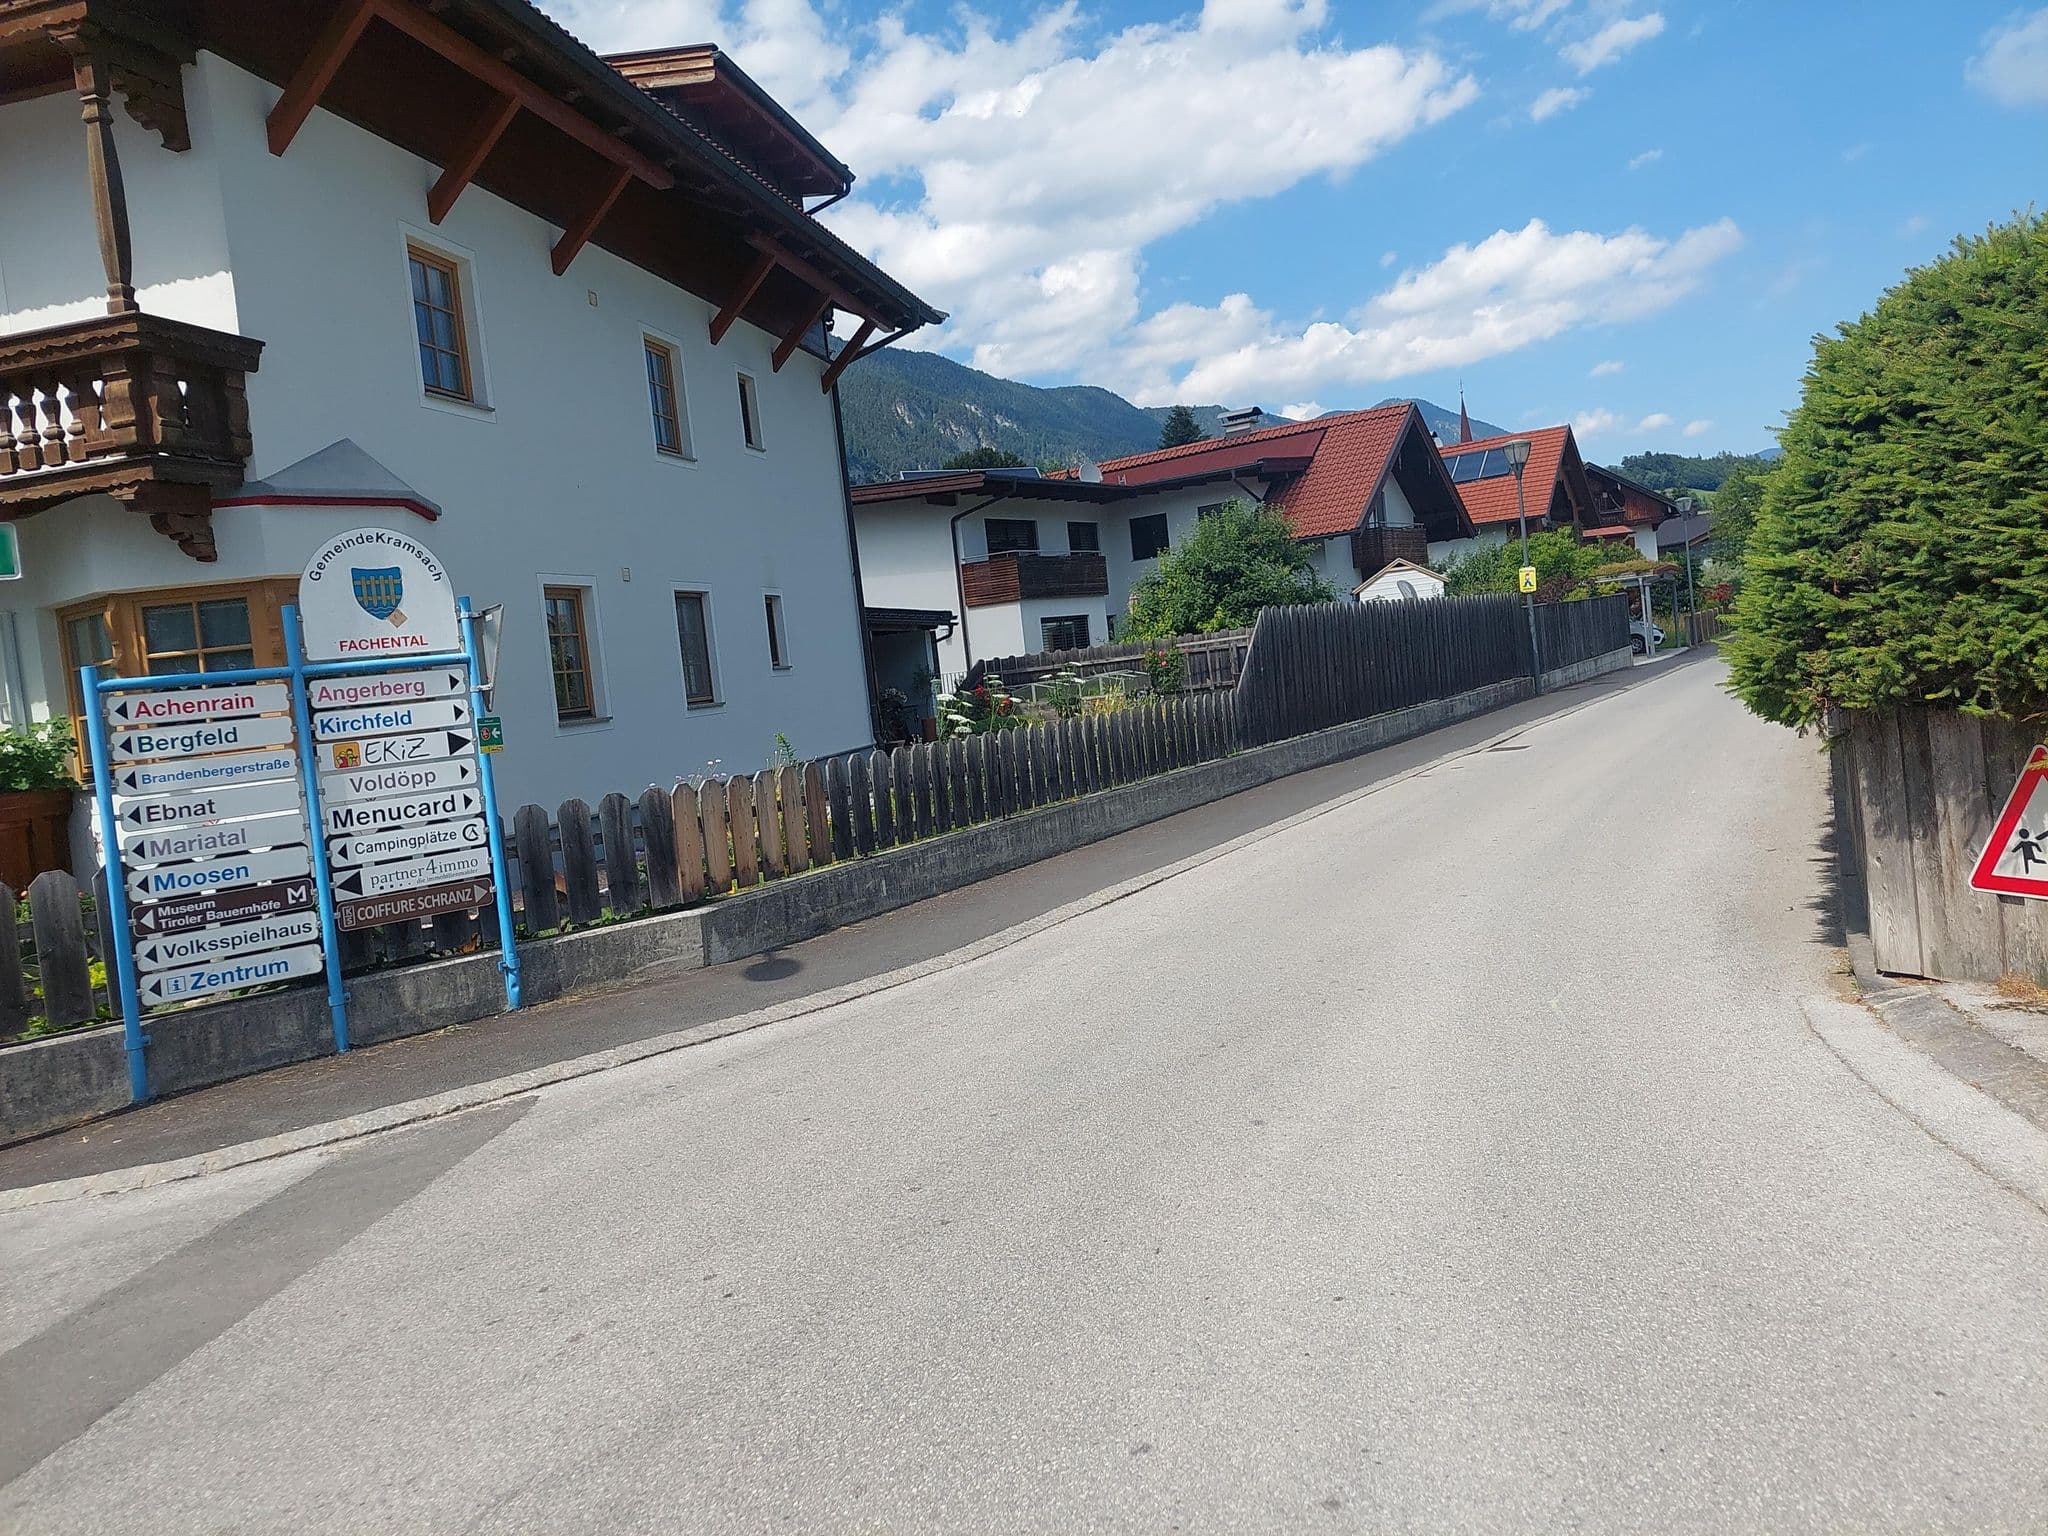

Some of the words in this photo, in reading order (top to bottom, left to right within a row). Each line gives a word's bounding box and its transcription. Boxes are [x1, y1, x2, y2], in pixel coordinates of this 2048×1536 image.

[339, 635, 428, 651] FACHENTAL
[317, 681, 425, 703] Angerberg
[134, 693, 255, 718] Achenrain
[319, 710, 412, 734] Kirchfeld
[137, 727, 238, 753] Bergfeld
[141, 759, 290, 785] Brandenbergerstraße
[349, 770, 436, 793] Voldöpp
[146, 799, 216, 822] Ebnat
[332, 794, 456, 829] Menucard
[149, 828, 247, 857] Mariatal
[354, 830, 457, 855] Campingplätze
[153, 865, 249, 892] Moosen
[370, 858, 478, 888] partner4immo
[157, 900, 216, 918] Museum
[158, 913, 202, 929] Tiroler
[206, 900, 281, 922] Bauernhöfe
[357, 896, 417, 921] COIFFURE
[418, 888, 473, 911] SCHRANZ
[162, 921, 313, 959] Volksspielhaus
[190, 959, 289, 991] Zentrum
